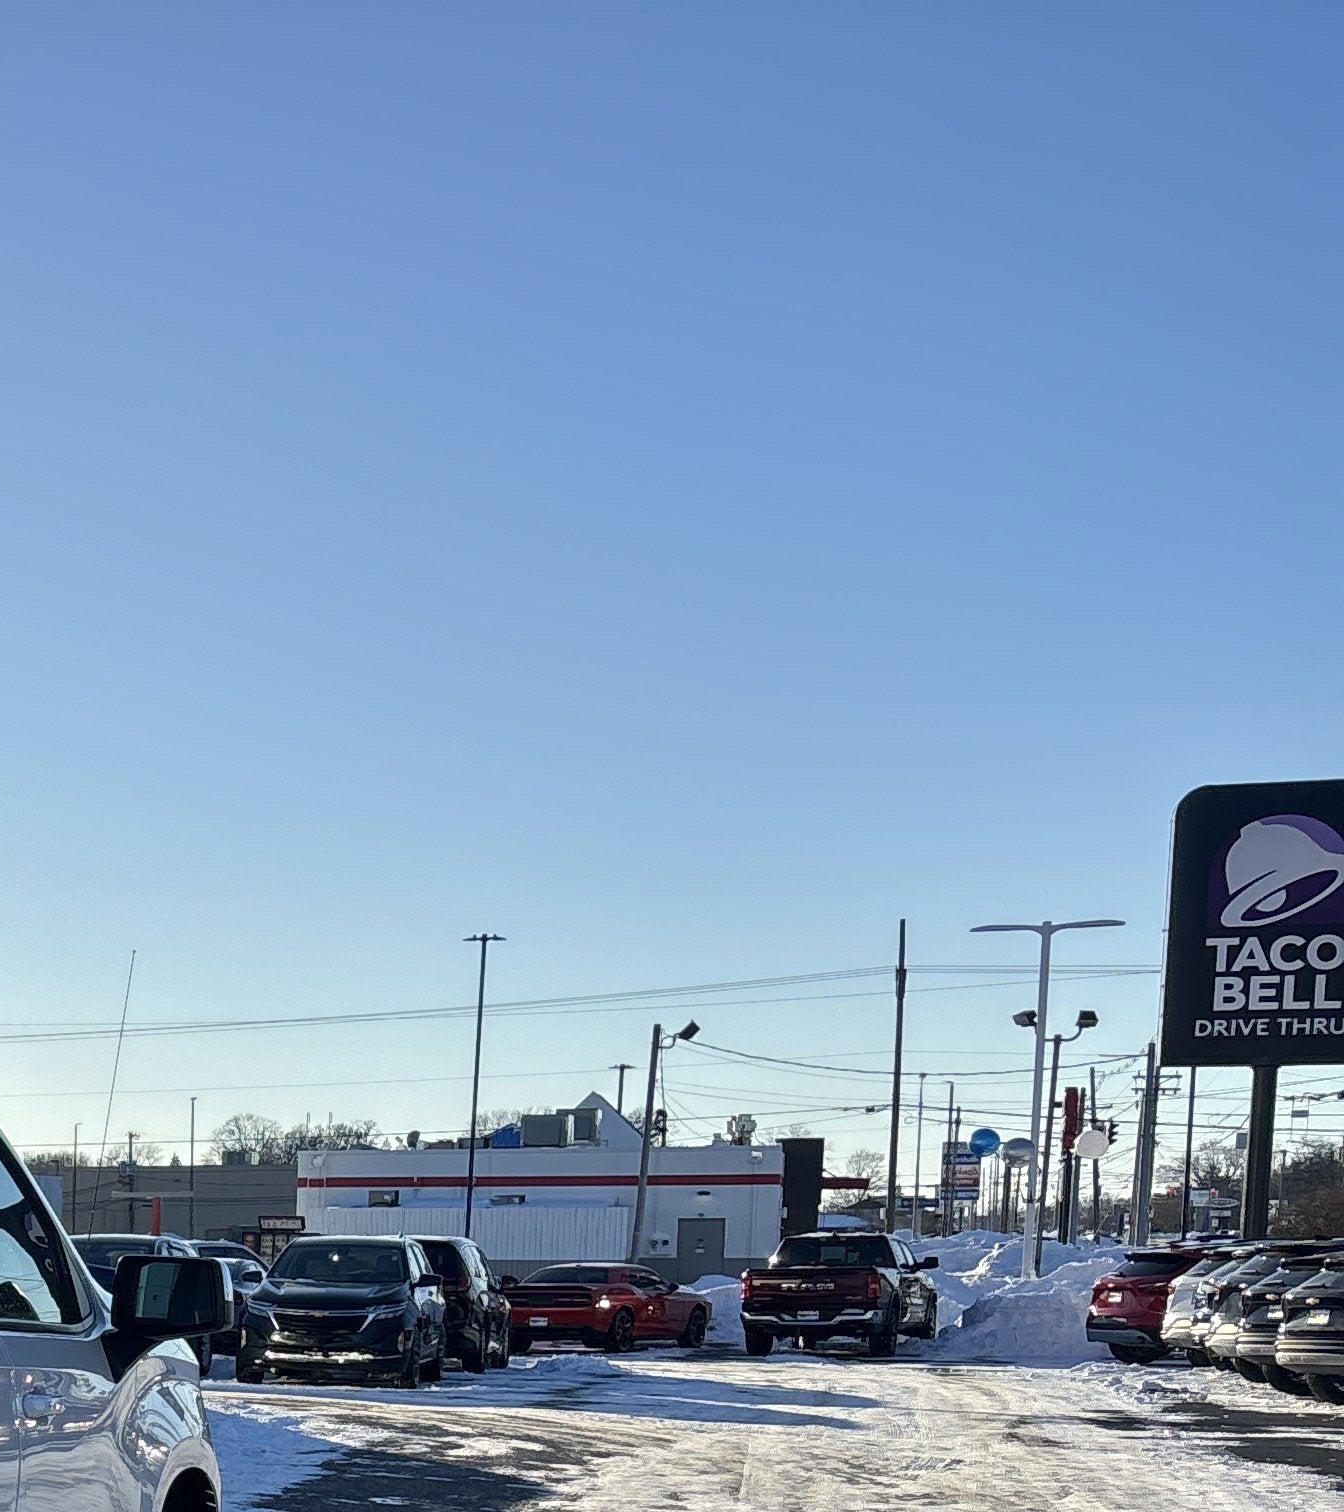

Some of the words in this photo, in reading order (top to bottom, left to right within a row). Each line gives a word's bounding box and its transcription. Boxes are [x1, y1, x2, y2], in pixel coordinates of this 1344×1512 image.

[1205, 934, 1344, 972] TACO
[1213, 974, 1342, 1011] BELL
[1194, 1018, 1270, 1037] DRIVE
[1277, 1017, 1344, 1036] THRU
